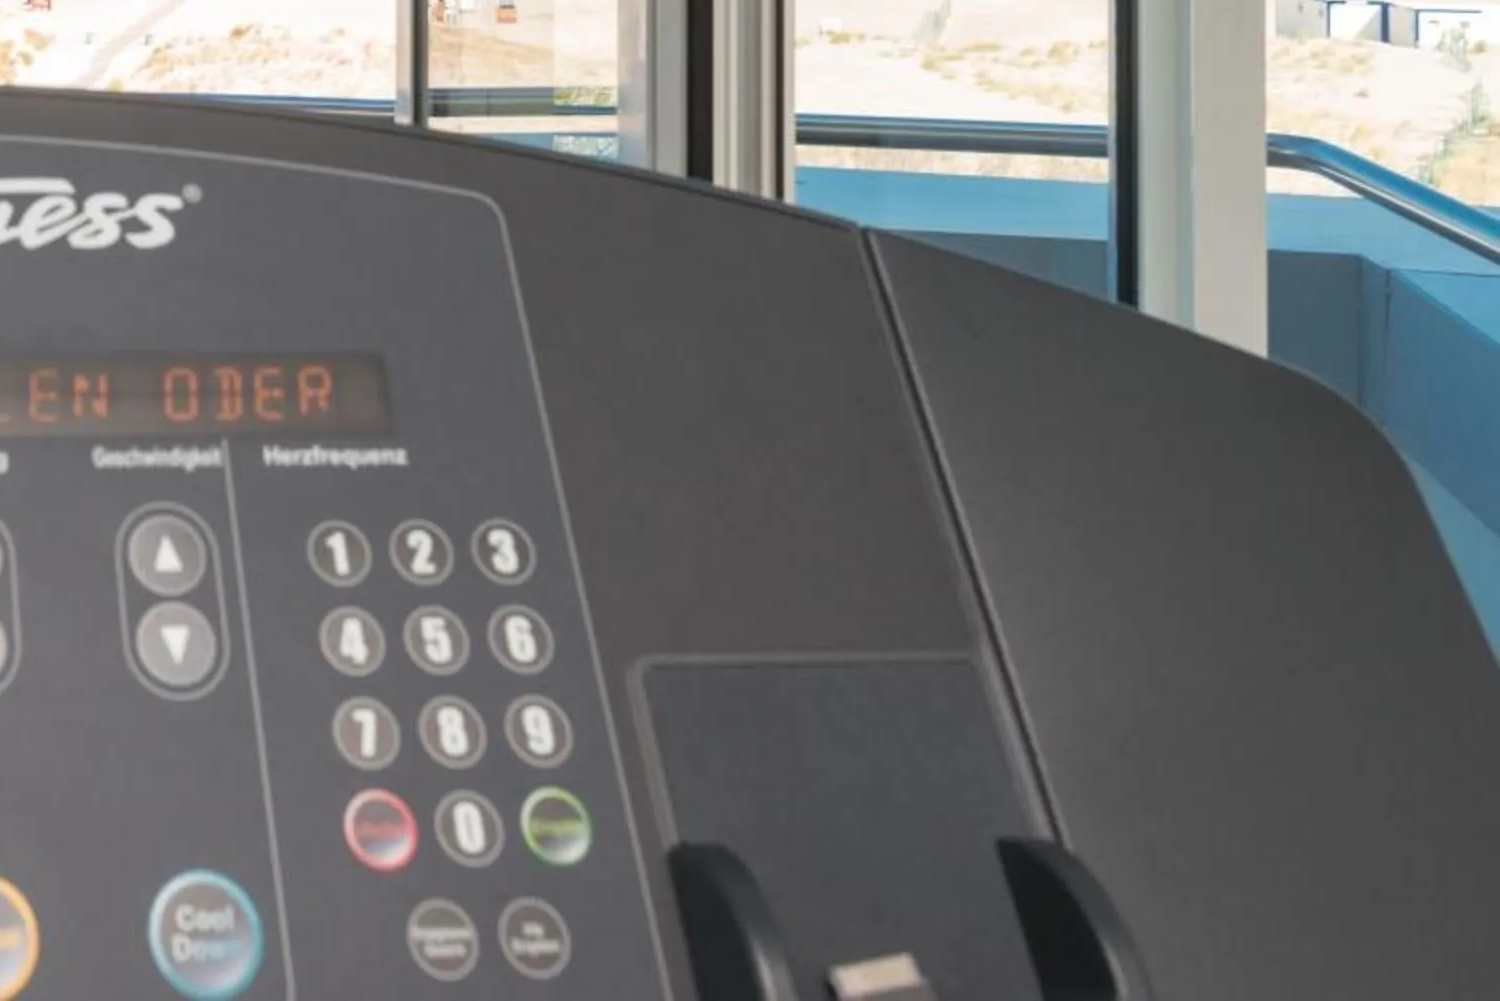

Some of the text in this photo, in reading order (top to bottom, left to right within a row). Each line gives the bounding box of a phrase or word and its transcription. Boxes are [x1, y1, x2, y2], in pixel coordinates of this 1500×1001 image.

[162, 364, 334, 422] ODER
[262, 444, 408, 470] Herzfrequenz
[325, 528, 519, 576] 1 2 3
[339, 614, 537, 664] 4 5 6
[352, 704, 555, 758] 7 8 9
[453, 801, 486, 854] 0
[175, 903, 235, 932] Cool
